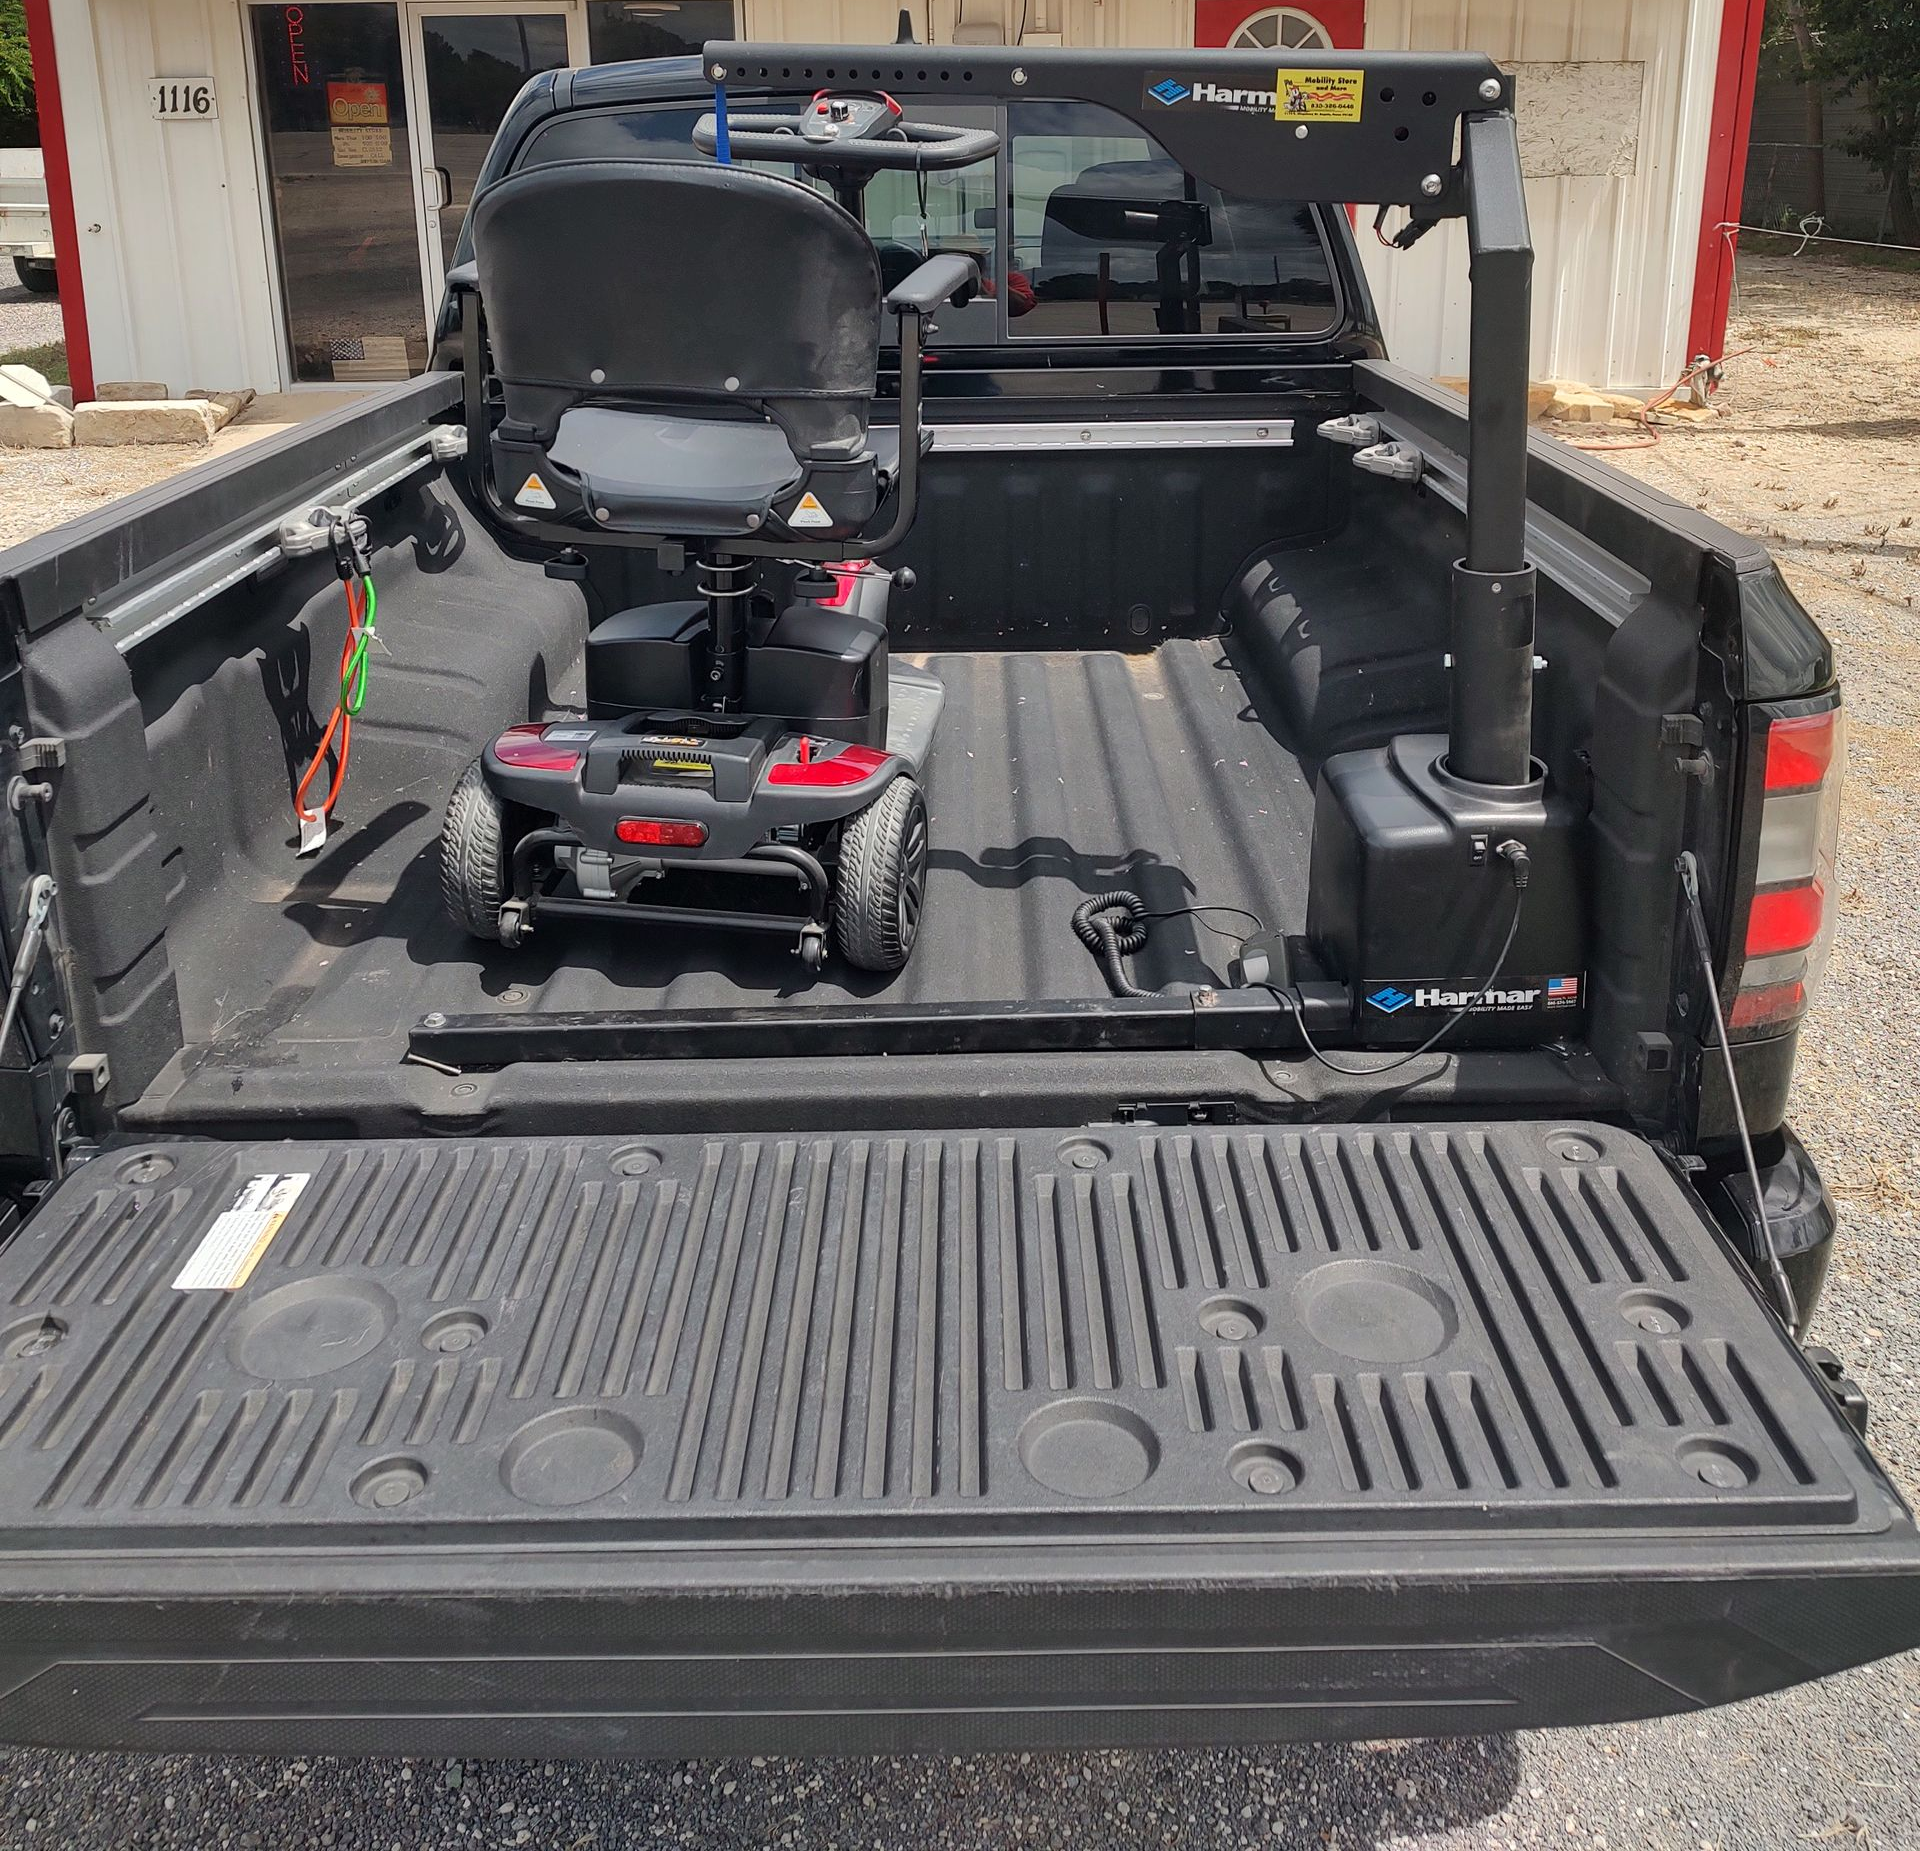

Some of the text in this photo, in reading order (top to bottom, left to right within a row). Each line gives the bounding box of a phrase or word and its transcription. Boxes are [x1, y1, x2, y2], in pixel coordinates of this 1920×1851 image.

[286, 6, 310, 87] OPEN
[1304, 76, 1336, 85] Mobility
[159, 85, 211, 114] 1116
[1192, 82, 1277, 106] Harm
[332, 98, 382, 121] Open
[1415, 988, 1541, 1006] Harmar
